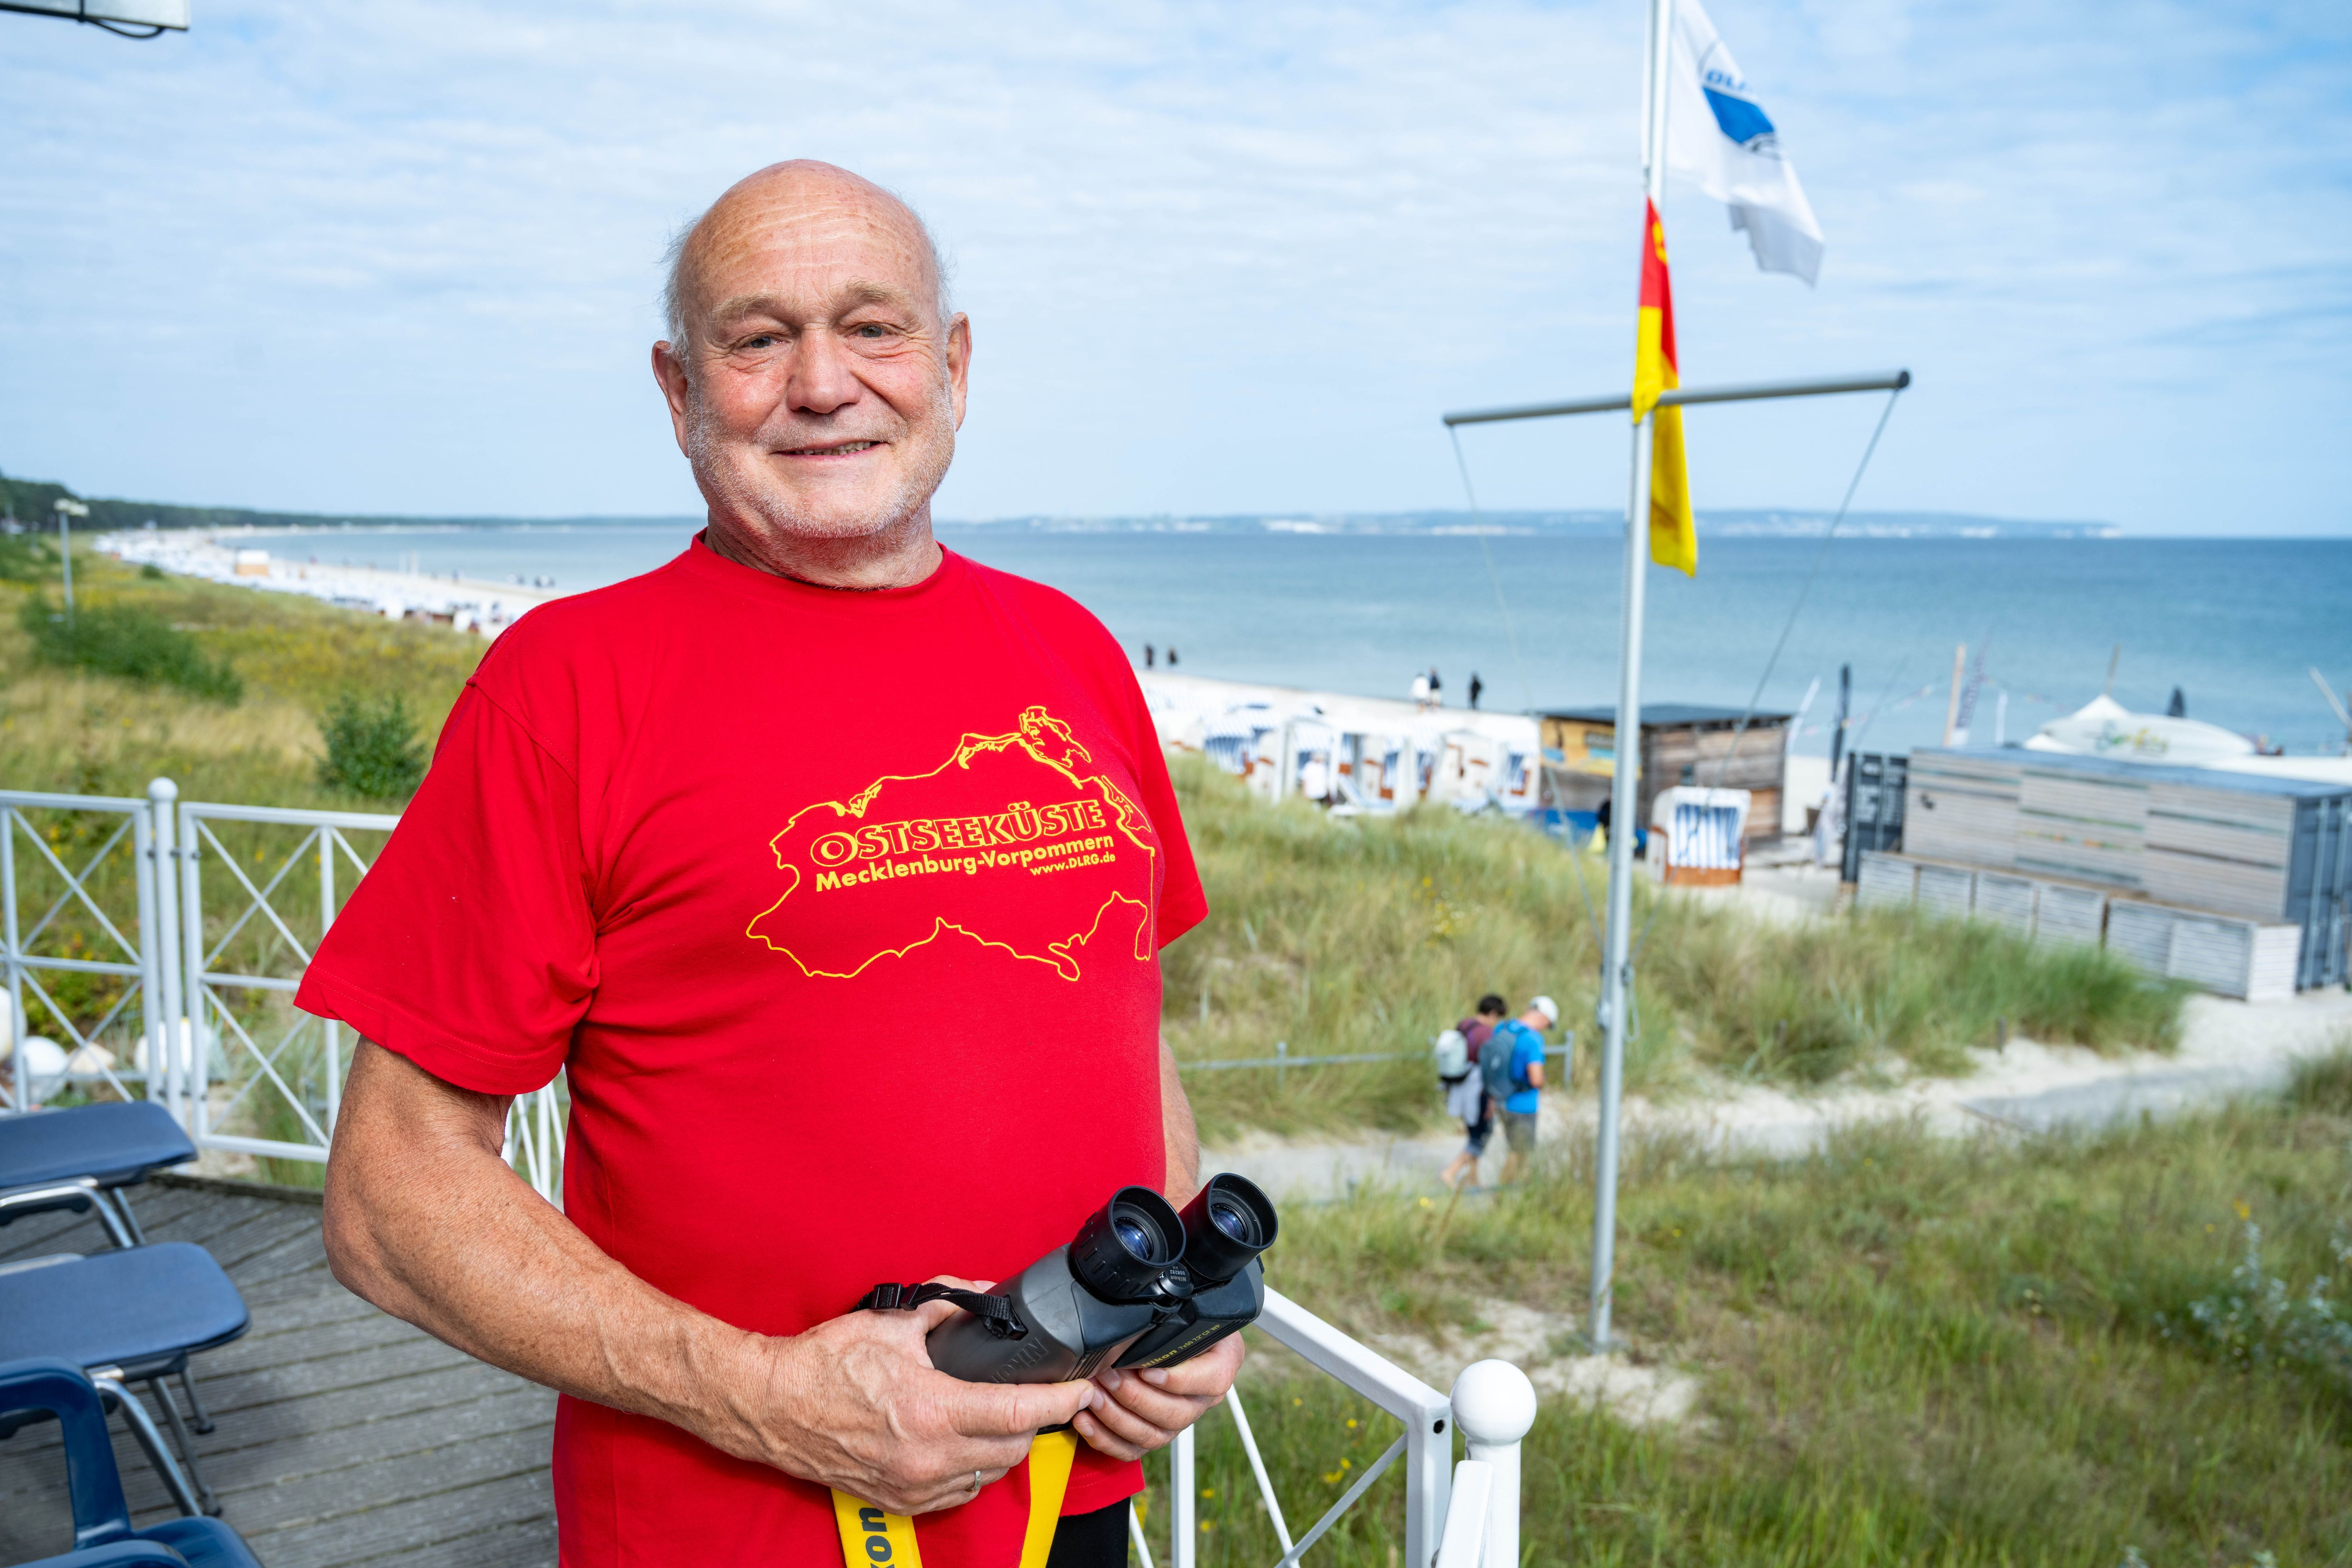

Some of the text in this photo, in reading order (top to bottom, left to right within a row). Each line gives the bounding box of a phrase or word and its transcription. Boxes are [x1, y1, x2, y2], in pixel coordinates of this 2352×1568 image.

[810, 800, 1107, 867] OSTSEEKÜSTE
[816, 835, 1114, 892] Mecklenburg-Vorpommern
[1030, 851, 1116, 875] www.DLRG.de
[1141, 1349, 1178, 1367] Nikon
[1178, 1341, 1194, 1349] 7x50
[858, 1507, 895, 1568] on
